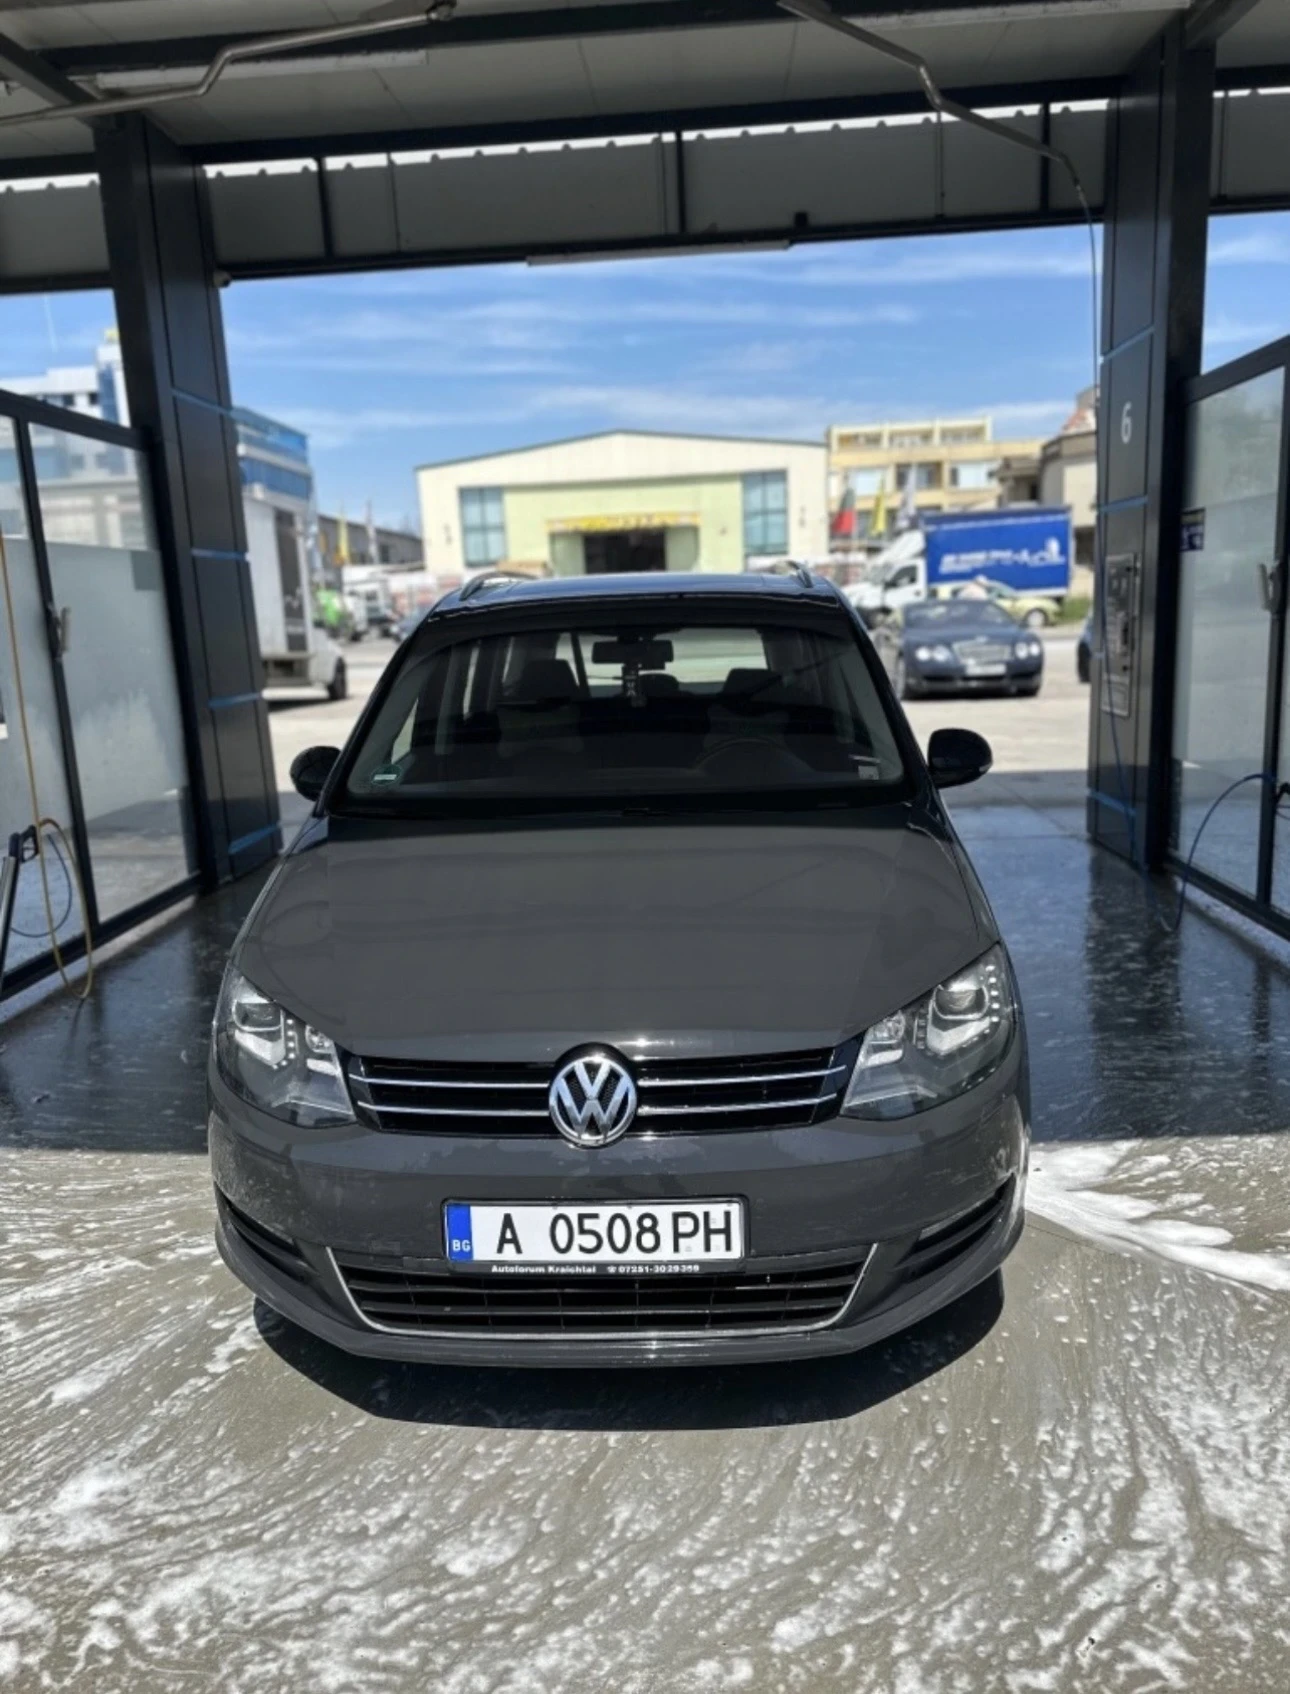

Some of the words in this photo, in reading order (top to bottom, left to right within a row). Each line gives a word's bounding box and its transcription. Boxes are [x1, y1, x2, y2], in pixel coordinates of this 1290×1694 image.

[1121, 401, 1132, 444] 6
[552, 1058, 635, 1144] VW
[452, 1239, 471, 1252] BG
[497, 1213, 523, 1254] A
[549, 1212, 661, 1254] 0508
[672, 1211, 732, 1253] PH
